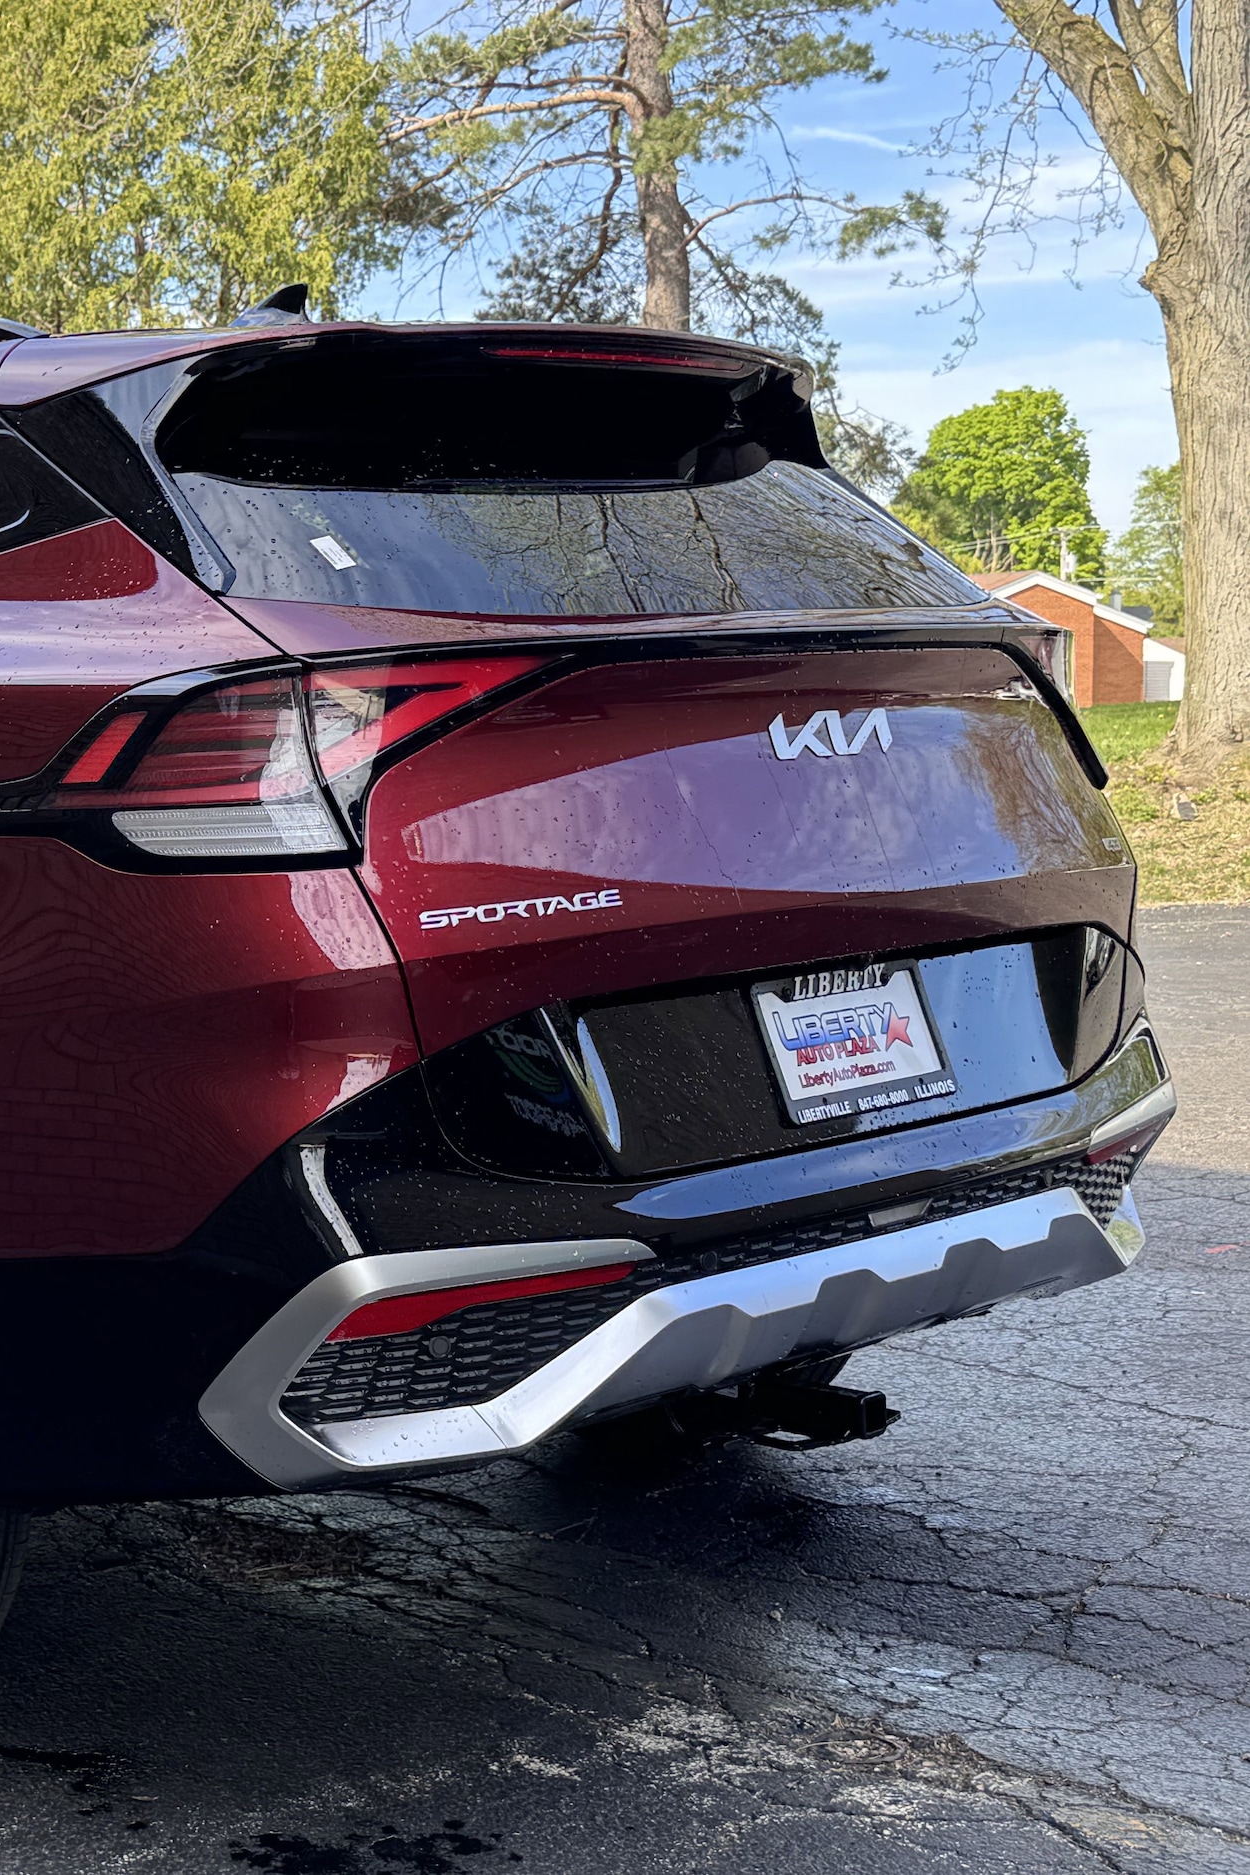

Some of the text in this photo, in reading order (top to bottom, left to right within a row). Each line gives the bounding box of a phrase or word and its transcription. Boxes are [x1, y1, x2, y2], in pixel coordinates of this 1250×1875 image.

[768, 708, 893, 760] KIA
[419, 889, 623, 930] SPORTAGE
[793, 963, 886, 1001] LIBERTY
[772, 1002, 893, 1051] LIBERTY
[796, 1037, 881, 1067] AUTO PLAZA
[798, 1061, 896, 1089] LibertyAutoPlaza.com
[797, 1101, 852, 1124] LIBERTYVILLE
[913, 1079, 956, 1099] ILLINOIS
